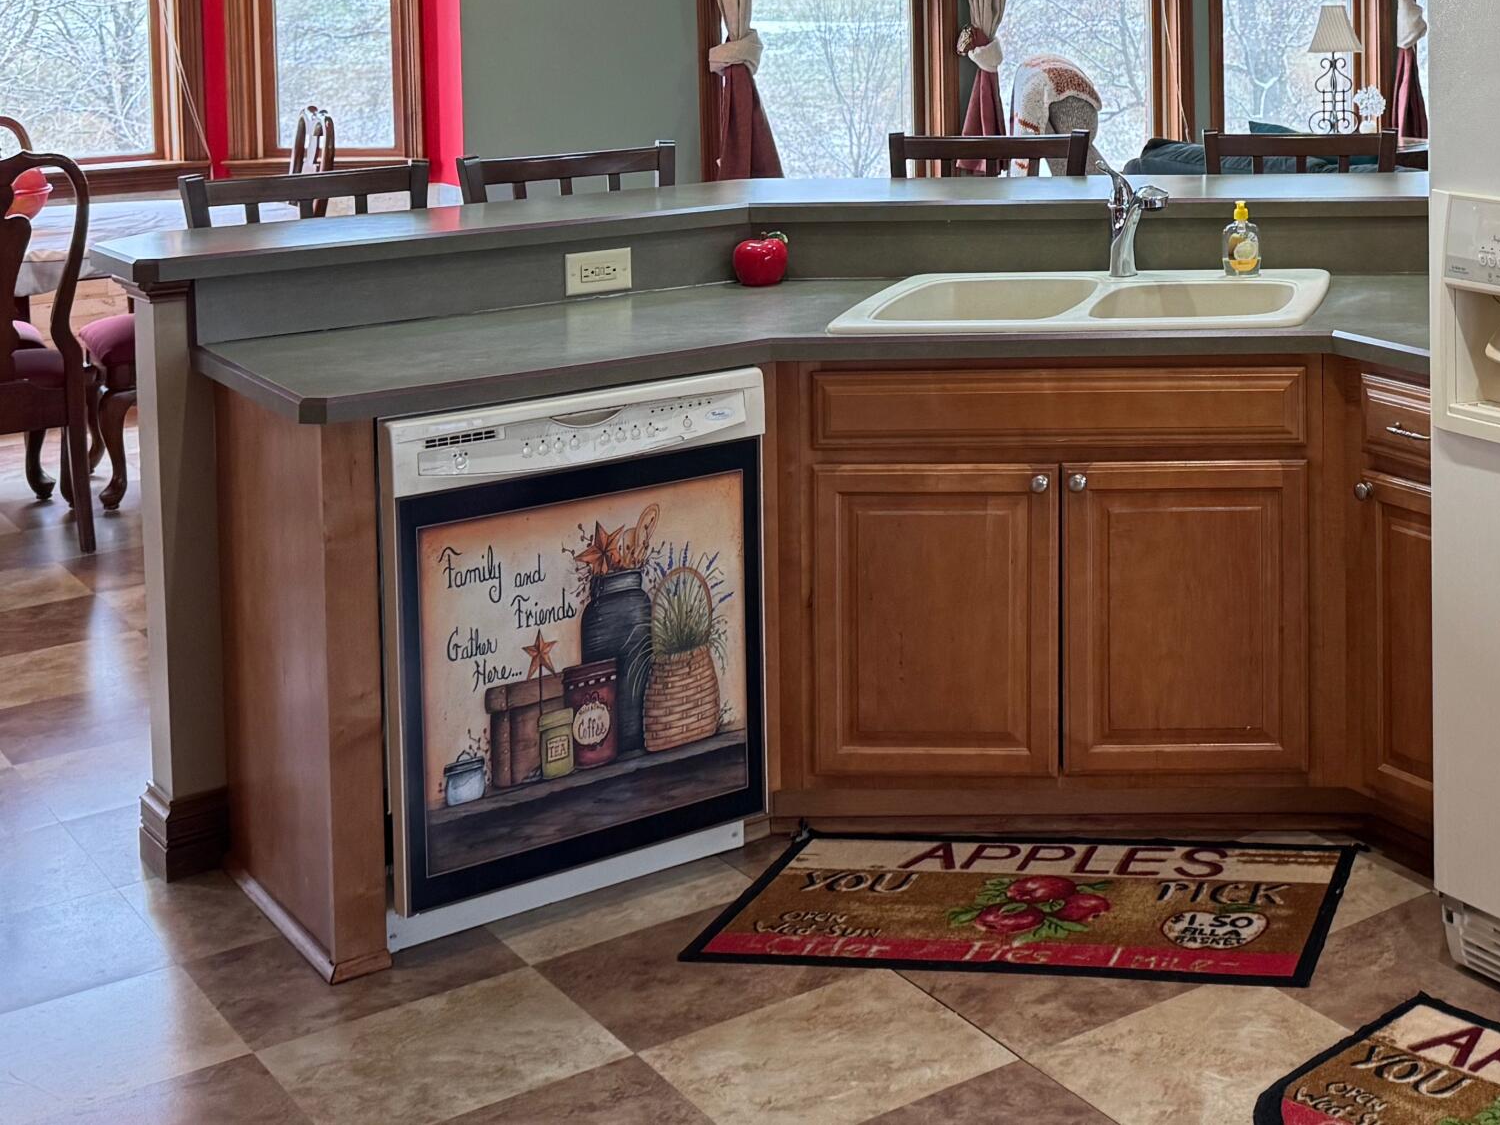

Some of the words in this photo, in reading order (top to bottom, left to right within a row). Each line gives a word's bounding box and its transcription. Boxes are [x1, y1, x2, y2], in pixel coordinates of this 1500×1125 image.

[438, 545, 502, 603] Family
[514, 553, 546, 588] and
[510, 587, 577, 629] Friends
[447, 626, 498, 661] Gather
[578, 717, 607, 740] Coffee
[549, 743, 567, 758] TEA
[898, 842, 1229, 878] APPLES
[800, 871, 919, 894] YOU
[1157, 880, 1292, 905] PICK
[1170, 913, 1254, 928] $1.50
[1350, 1044, 1471, 1098] YOU
